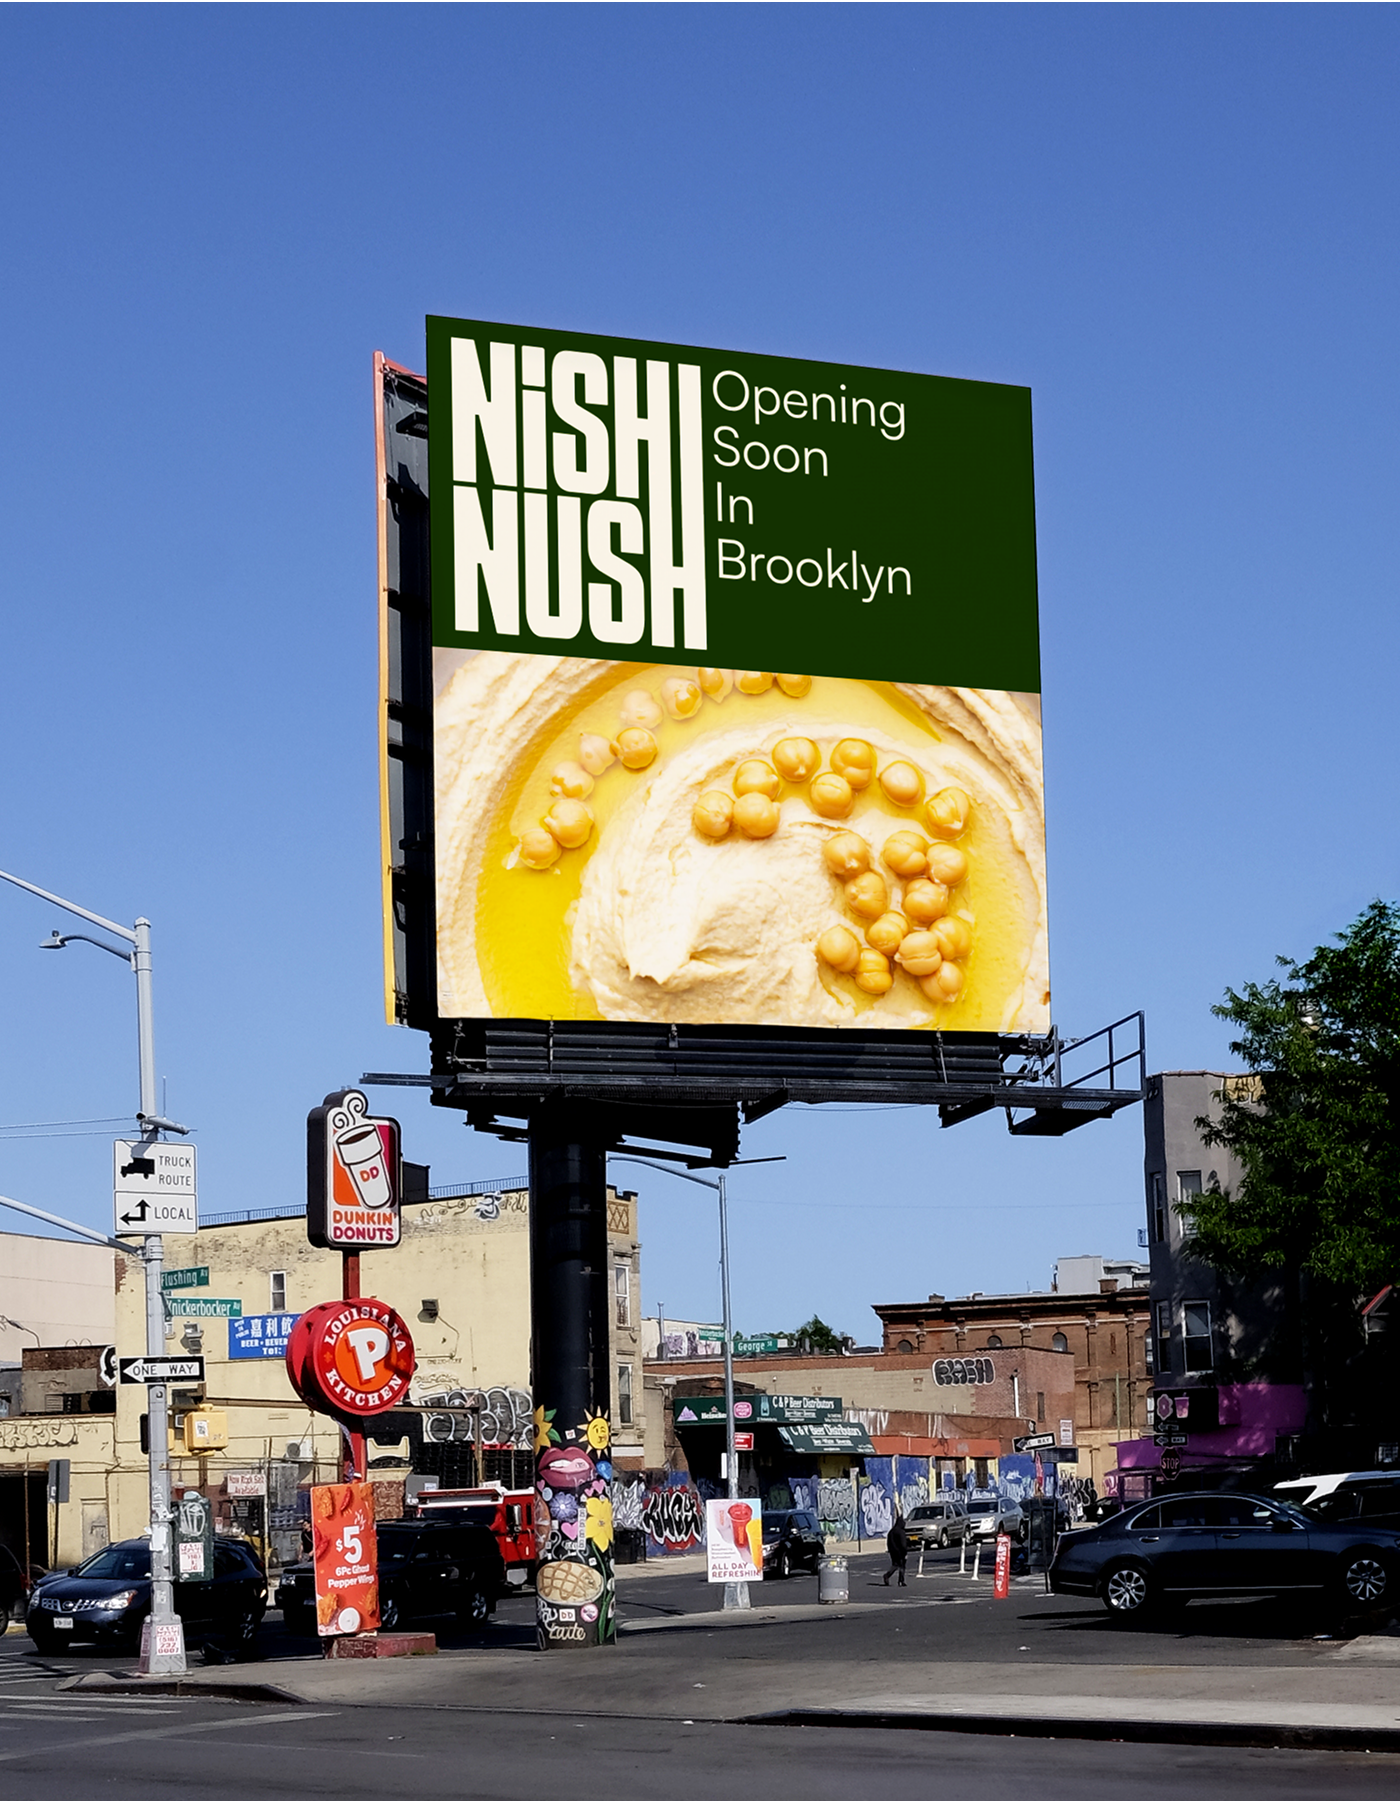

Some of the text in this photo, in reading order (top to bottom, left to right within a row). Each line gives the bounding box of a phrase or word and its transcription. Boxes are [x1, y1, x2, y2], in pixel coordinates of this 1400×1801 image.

[712, 369, 906, 441] Opening
[713, 426, 829, 477] Soon
[716, 481, 754, 525] In
[717, 538, 912, 603] Brooklyn
[158, 1155, 192, 1168] TRUCK
[158, 1174, 192, 1187] ROUTE
[359, 1165, 380, 1183] DD
[154, 1206, 194, 1221] LOCAL
[332, 1210, 397, 1226] DUNKIN'
[333, 1226, 394, 1241] DONUTS
[161, 1270, 198, 1287] Flushing
[166, 1299, 232, 1316] Knickerbocker
[250, 1315, 302, 1338] 嘉利飲
[323, 1306, 407, 1352] LOUISIANA
[264, 1338, 289, 1347] BEVER
[737, 1342, 765, 1352] George
[346, 1327, 391, 1380] P
[132, 1364, 194, 1376] ONE WAY
[325, 1370, 402, 1407] KITCHEN
[1161, 1457, 1180, 1470] STOP
[335, 1525, 363, 1564] $5
[335, 1565, 351, 1577] 6Pc
[711, 1562, 748, 1571] ALL DAY
[327, 1577, 357, 1589] Pepper
